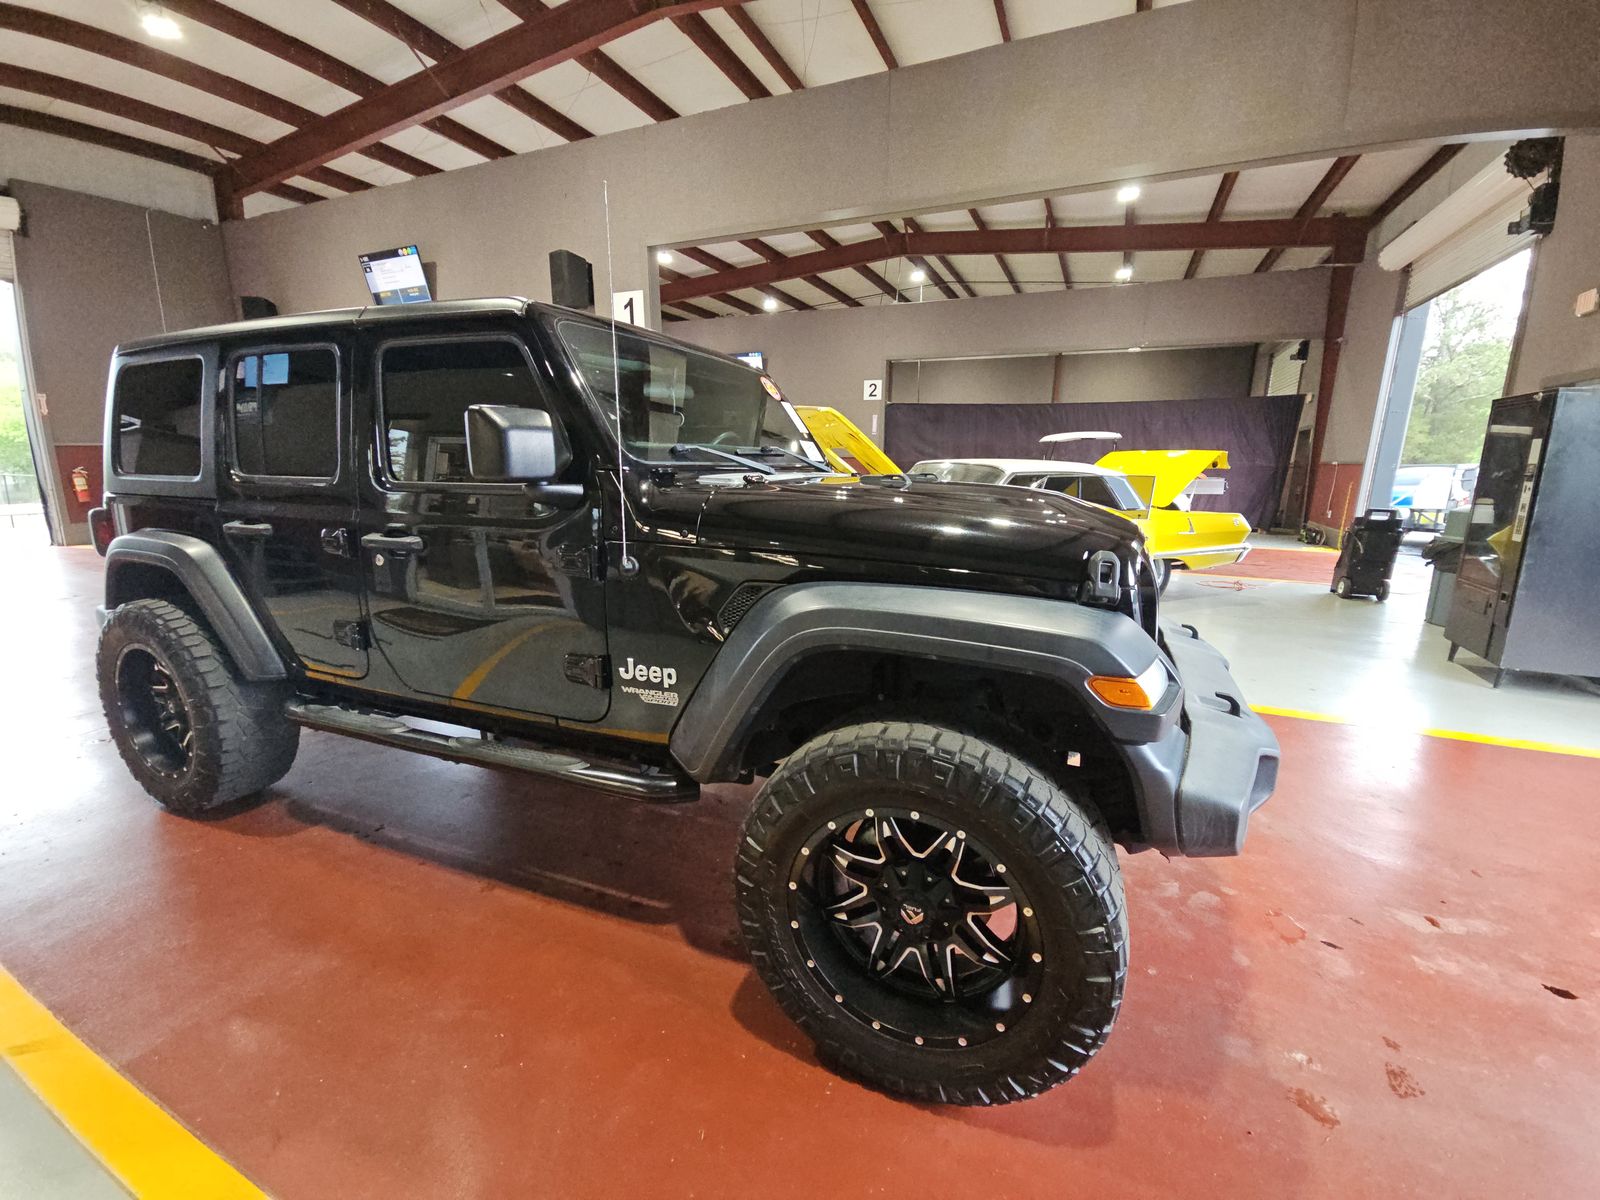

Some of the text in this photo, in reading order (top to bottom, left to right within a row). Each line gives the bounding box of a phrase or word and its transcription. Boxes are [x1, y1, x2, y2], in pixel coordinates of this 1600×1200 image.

[624, 298, 634, 324] 1
[869, 383, 878, 397] 2
[619, 658, 677, 688] Jeep
[620, 685, 679, 698] WRANGLER
